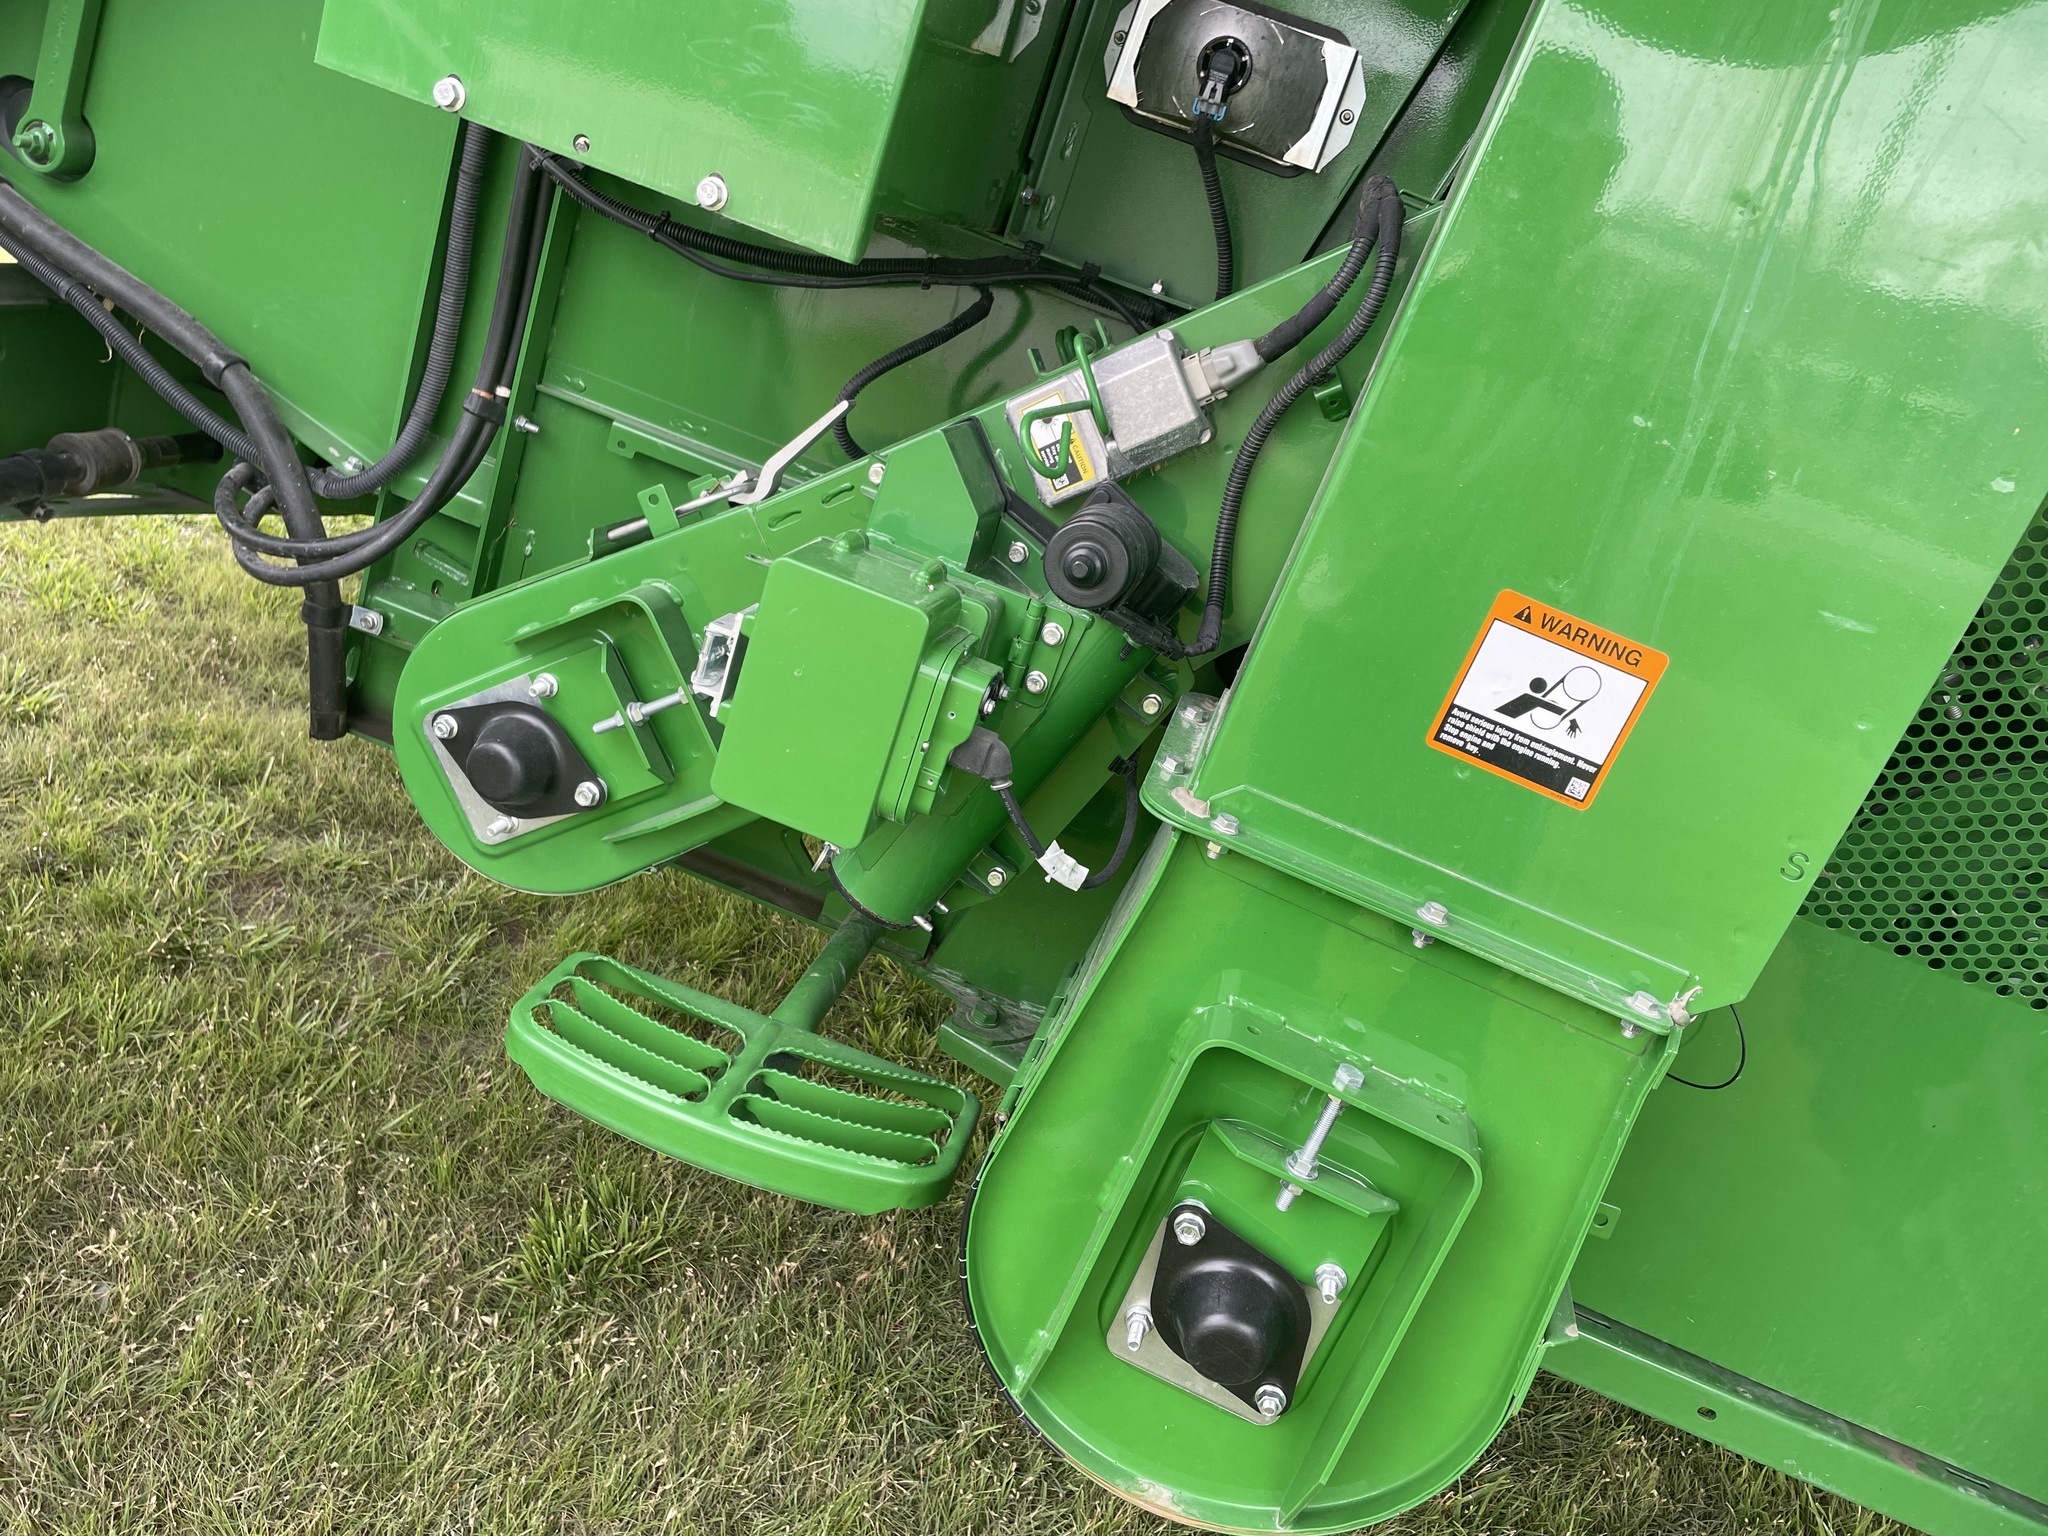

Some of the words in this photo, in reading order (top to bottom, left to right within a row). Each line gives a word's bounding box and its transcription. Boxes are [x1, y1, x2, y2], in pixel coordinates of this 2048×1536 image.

[1072, 444, 1089, 474] CAUTION
[1541, 612, 1643, 668] WARNING
[1439, 732, 1465, 747] remove
[1443, 723, 1460, 736] Stop
[1459, 731, 1482, 745] engine
[1481, 740, 1496, 751] and
[1447, 716, 1465, 728] raise
[1464, 723, 1487, 737] shield
[1485, 731, 1501, 743] with
[1500, 736, 1512, 748] the
[1511, 743, 1535, 758] engine
[1533, 752, 1561, 769] running.
[1451, 707, 1472, 721] Avoid
[1470, 715, 1495, 731] serious
[1494, 725, 1515, 740] injury
[1513, 733, 1531, 746] from
[1530, 741, 1576, 766] entanglement.
[1576, 759, 1598, 774] Never
[1779, 851, 1810, 882] S
